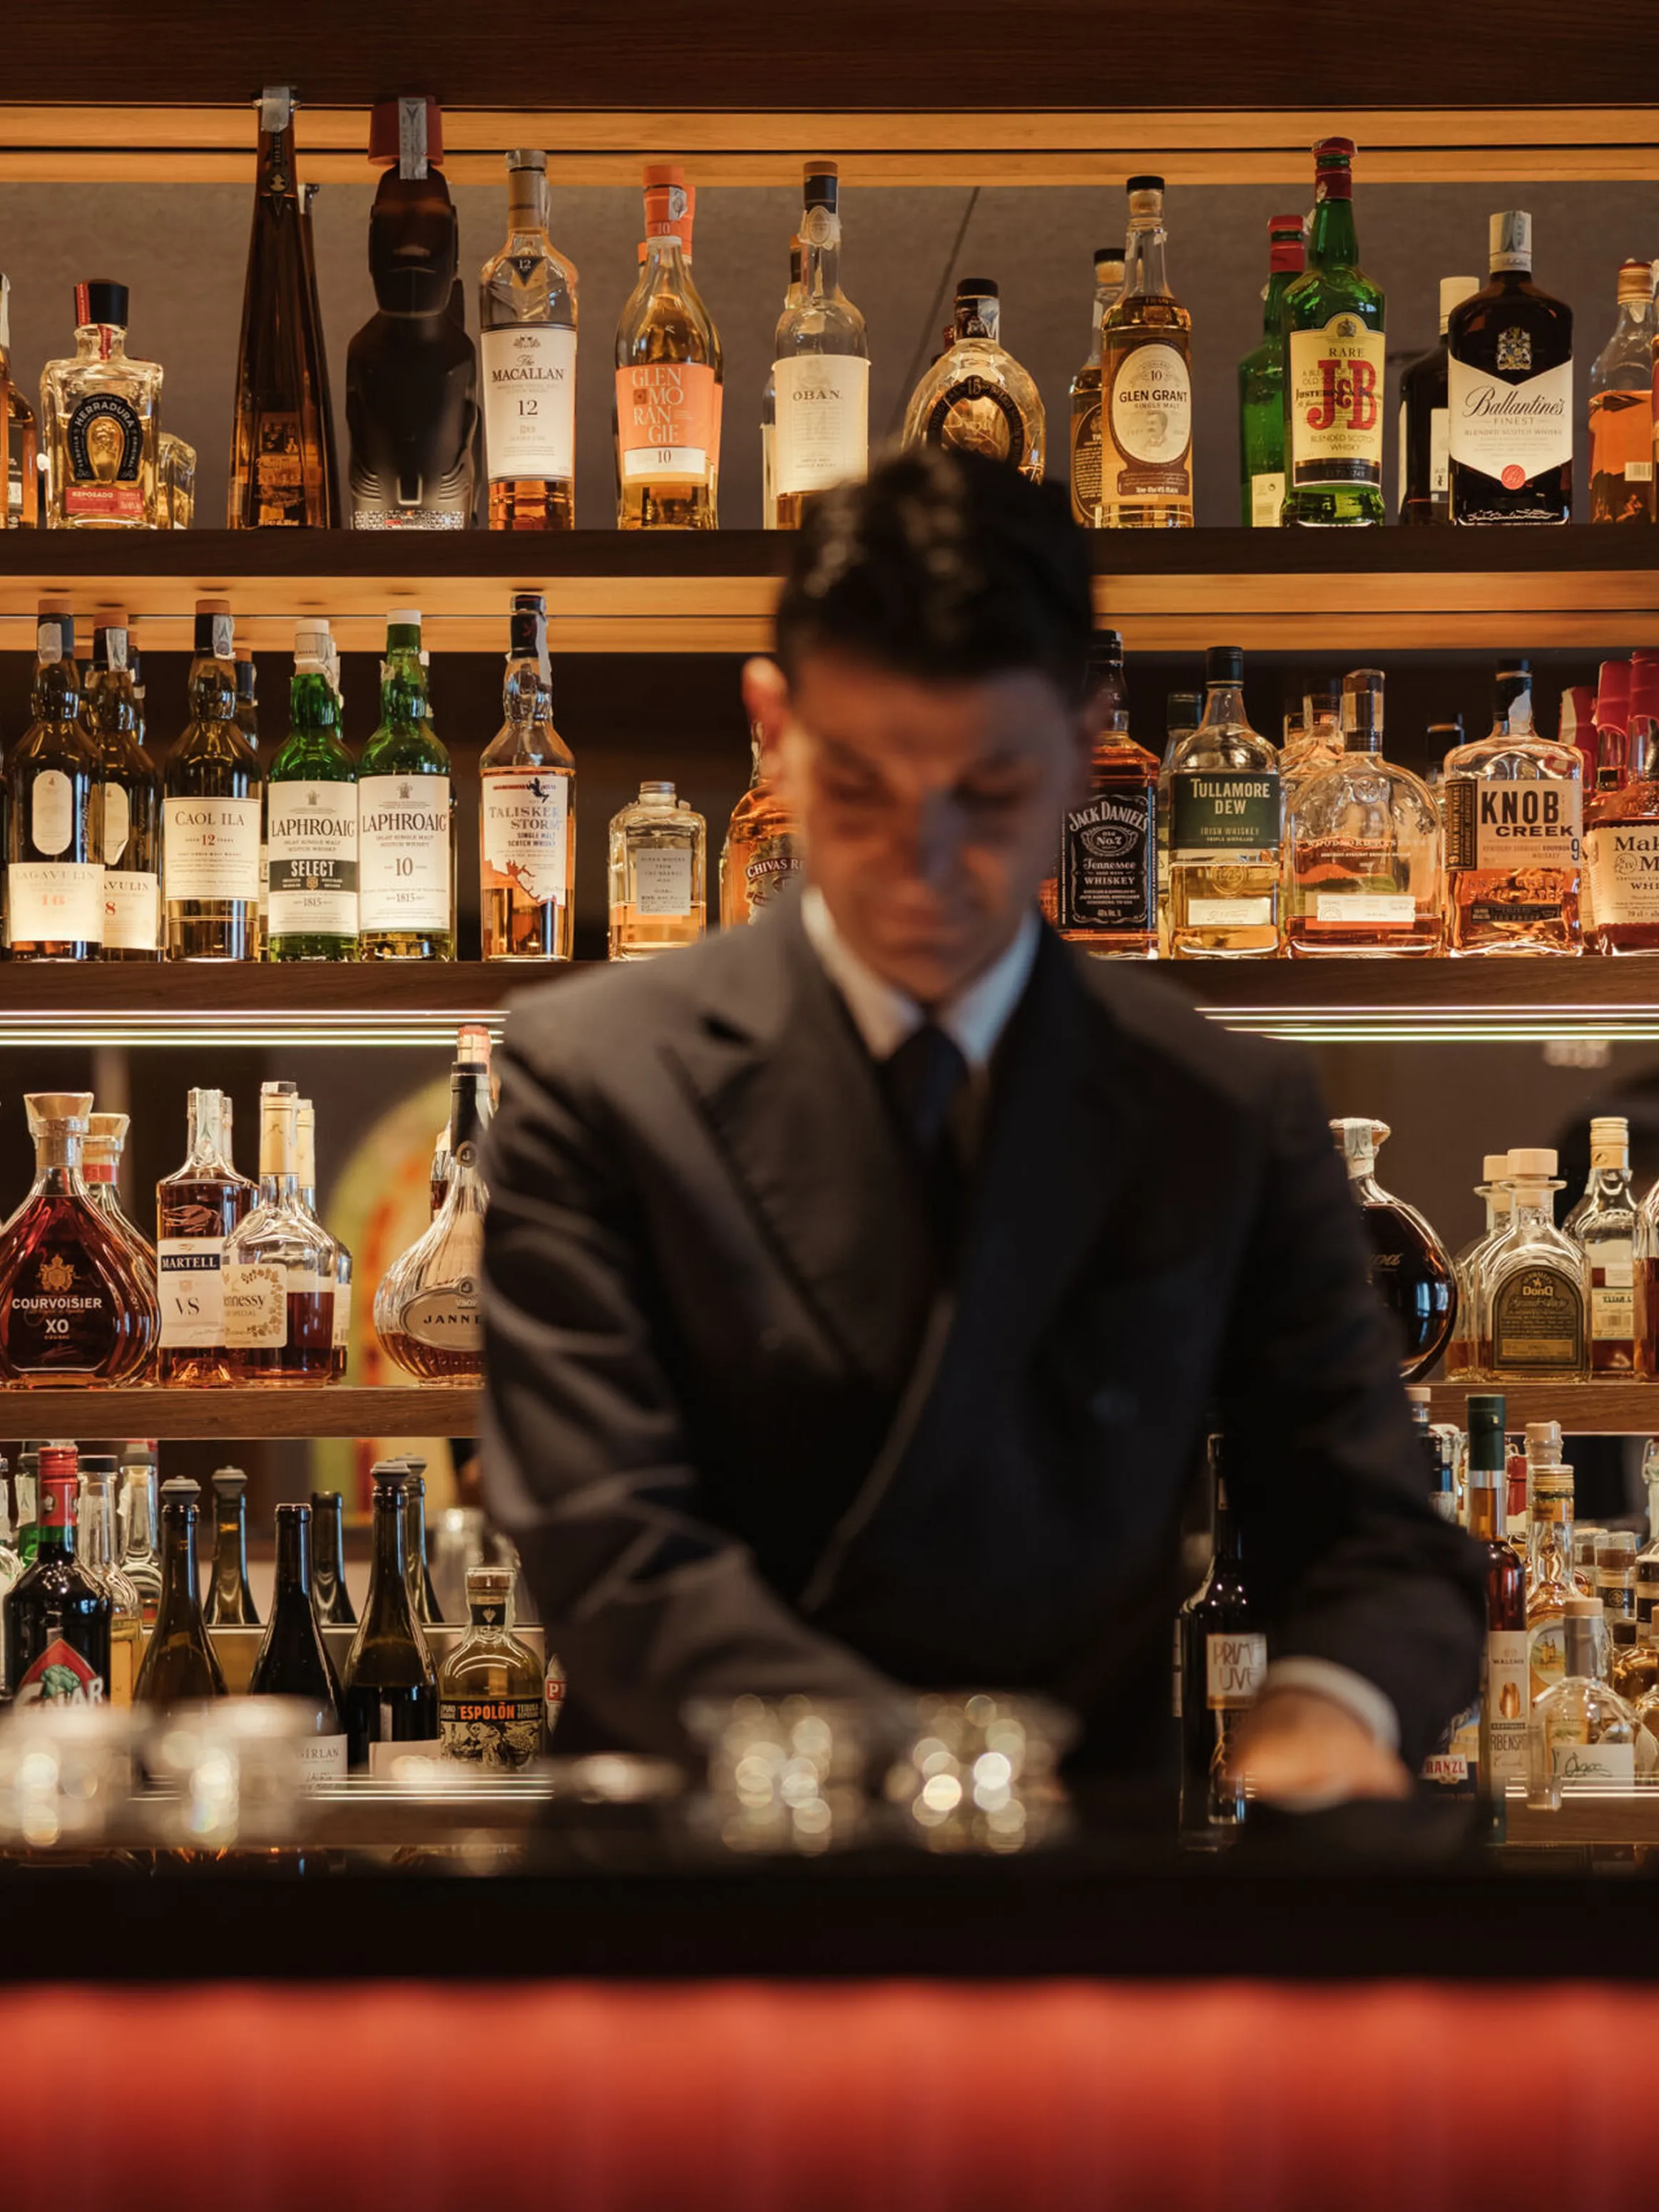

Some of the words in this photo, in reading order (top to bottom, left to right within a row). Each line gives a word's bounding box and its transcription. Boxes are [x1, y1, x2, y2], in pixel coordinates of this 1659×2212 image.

[518, 258, 531, 269] 12
[1329, 347, 1364, 357] RARE
[491, 367, 565, 383] MACALLAN
[632, 367, 682, 387] GLEN
[1150, 369, 1163, 382] 10
[648, 387, 685, 406] MO
[792, 389, 840, 402] OBAN
[1118, 389, 1150, 403] GLEN
[1152, 389, 1188, 402] GRANT
[1307, 359, 1377, 431] J&B
[1461, 384, 1565, 418] Ballantine's
[74, 401, 136, 427] HERRADURA
[518, 399, 538, 417] 12
[633, 405, 672, 426] RAN
[1494, 417, 1536, 426] FINEST
[648, 424, 679, 444] GIE
[657, 449, 672, 464] 10
[1190, 778, 1271, 798] TULLAMORE
[489, 806, 560, 819] TALISKER
[1215, 799, 1247, 815] DEW
[1481, 790, 1559, 825] KNOB
[175, 810, 216, 827] CAOL
[221, 812, 245, 827] ILA
[362, 812, 447, 833] LAPHROAIG
[511, 818, 560, 831] STORM
[1068, 806, 1100, 832] JACK
[271, 817, 356, 837] LAPHROAIG
[1495, 825, 1575, 837] CREEK
[201, 833, 216, 846] 12
[1571, 837, 1581, 861] 9
[291, 860, 335, 877] SELECT
[395, 857, 414, 877] 10
[747, 858, 788, 880] CHIVAS
[1083, 858, 1136, 870] Tennessee
[1083, 877, 1136, 886] WHISKEY
[105, 901, 116, 916] 8
[161, 1256, 217, 1269] MARTELL
[1522, 1285, 1554, 1296] DonQ
[11, 1298, 103, 1309] COURVOISIER
[175, 1298, 200, 1315] VS
[45, 1319, 69, 1334] XO
